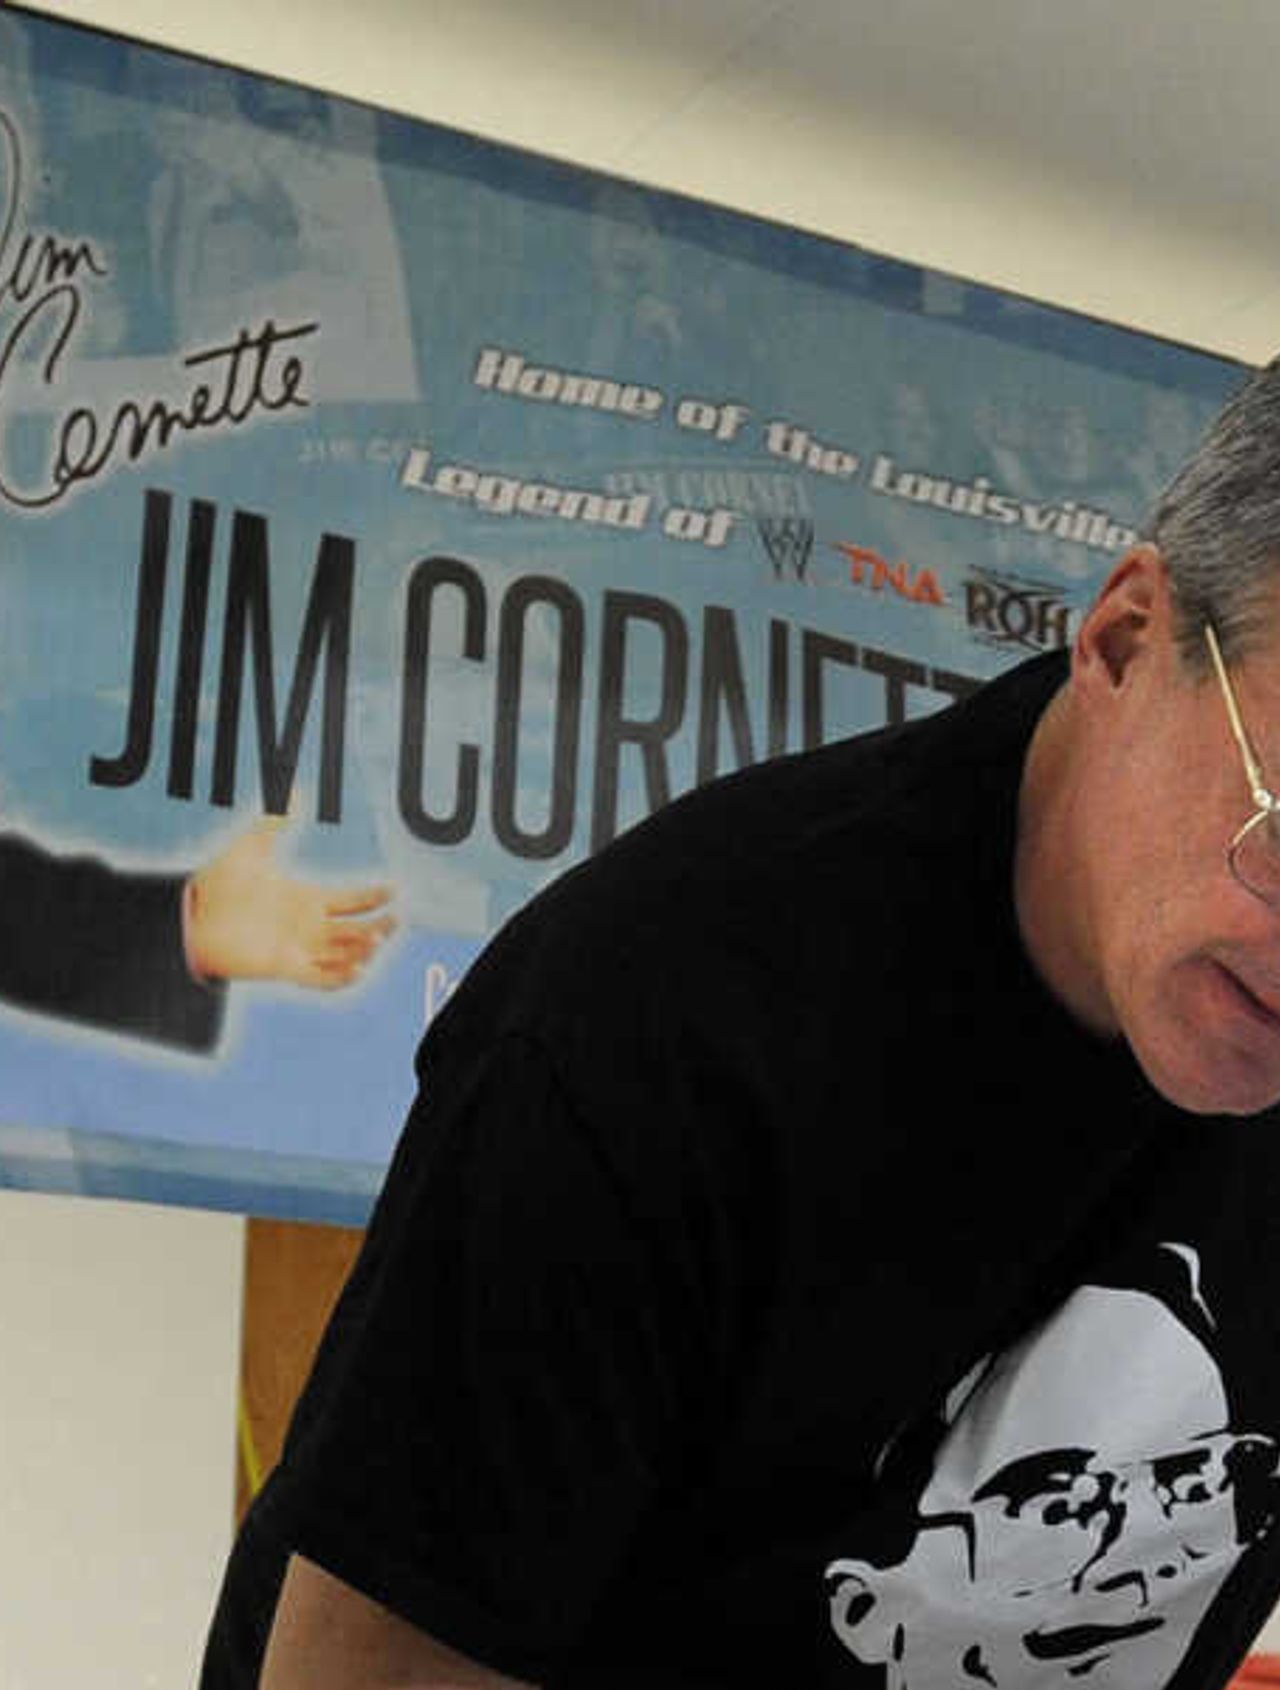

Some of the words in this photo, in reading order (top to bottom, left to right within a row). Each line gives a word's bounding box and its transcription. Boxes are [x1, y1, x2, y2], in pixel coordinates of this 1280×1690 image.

[401, 448, 651, 531] Legend
[664, 508, 744, 548] of
[832, 540, 950, 606] TNA
[475, 347, 664, 422] Home
[676, 399, 749, 442] of
[765, 421, 860, 475] the
[871, 454, 1141, 551] Louisville
[89, 487, 356, 826] JIM
